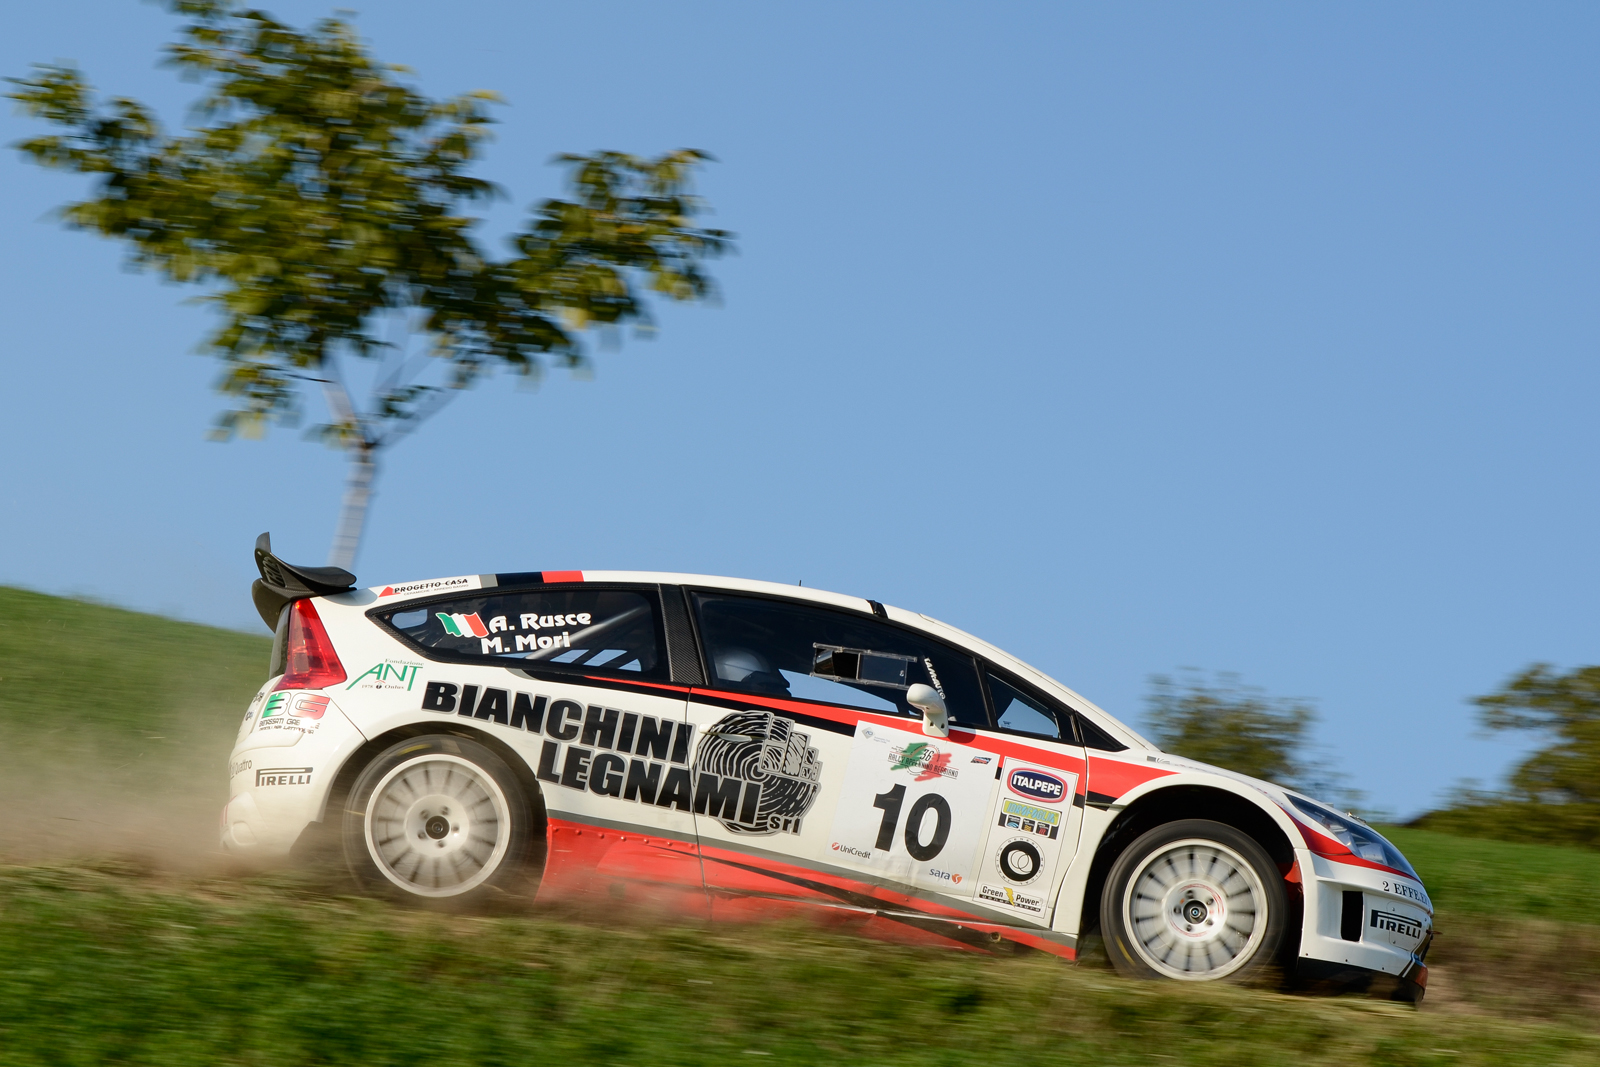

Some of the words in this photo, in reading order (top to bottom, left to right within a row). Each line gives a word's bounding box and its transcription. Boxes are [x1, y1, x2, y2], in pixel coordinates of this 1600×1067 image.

[489, 616, 515, 633] A.
[521, 612, 592, 630] Rusce
[481, 637, 510, 654] M.
[516, 632, 571, 651] Mori
[345, 663, 424, 691] ANT
[421, 680, 697, 765] BIANCHINI
[920, 748, 934, 762] 36
[255, 767, 313, 787] PIRELLI
[535, 738, 764, 827] LEGNAMI
[1012, 774, 1061, 796] ITALPEPE
[768, 814, 801, 834] srl
[873, 783, 952, 862] 10
[840, 844, 871, 859] UniCredit
[929, 868, 951, 880] sara
[982, 885, 1004, 898] Green
[1015, 894, 1040, 906] Power
[1382, 880, 1390, 892] 2
[1370, 909, 1423, 939] PIRELLI
